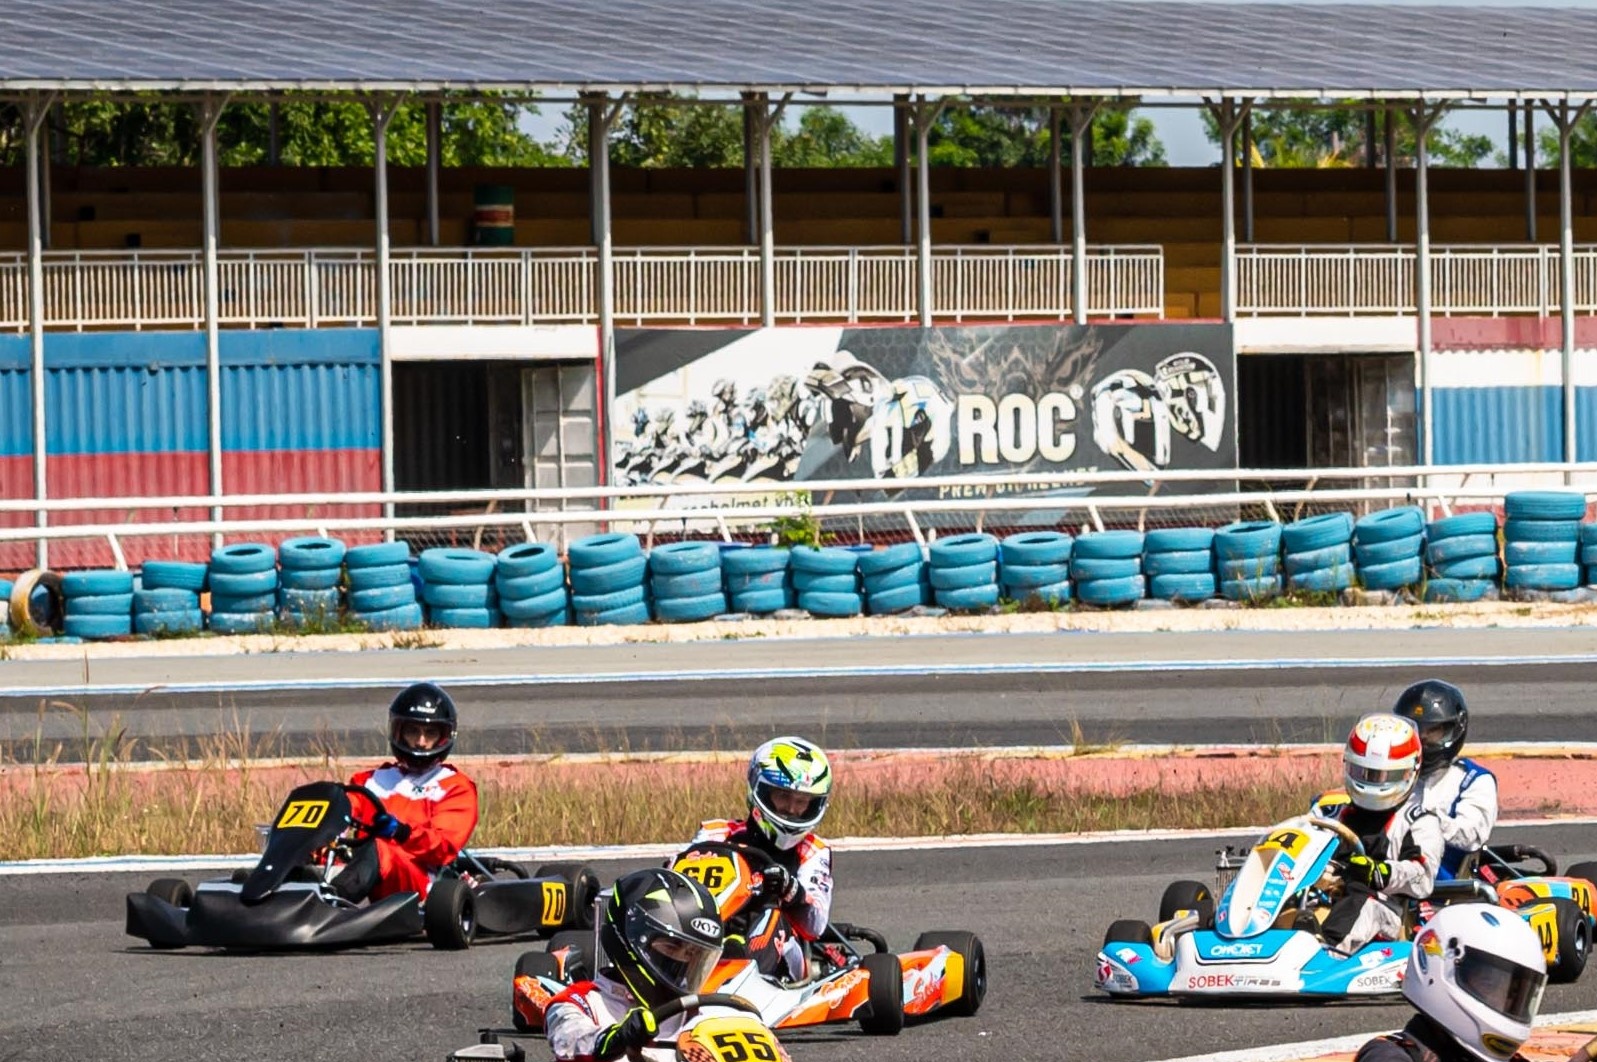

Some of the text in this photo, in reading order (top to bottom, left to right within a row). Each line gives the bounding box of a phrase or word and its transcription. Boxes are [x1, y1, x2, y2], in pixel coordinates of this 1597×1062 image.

[958, 392, 1077, 464] ROC
[285, 803, 325, 824] 70
[692, 919, 719, 936] KYT
[1188, 974, 1234, 988] SOBEK
[1357, 976, 1390, 987] SOBEK
